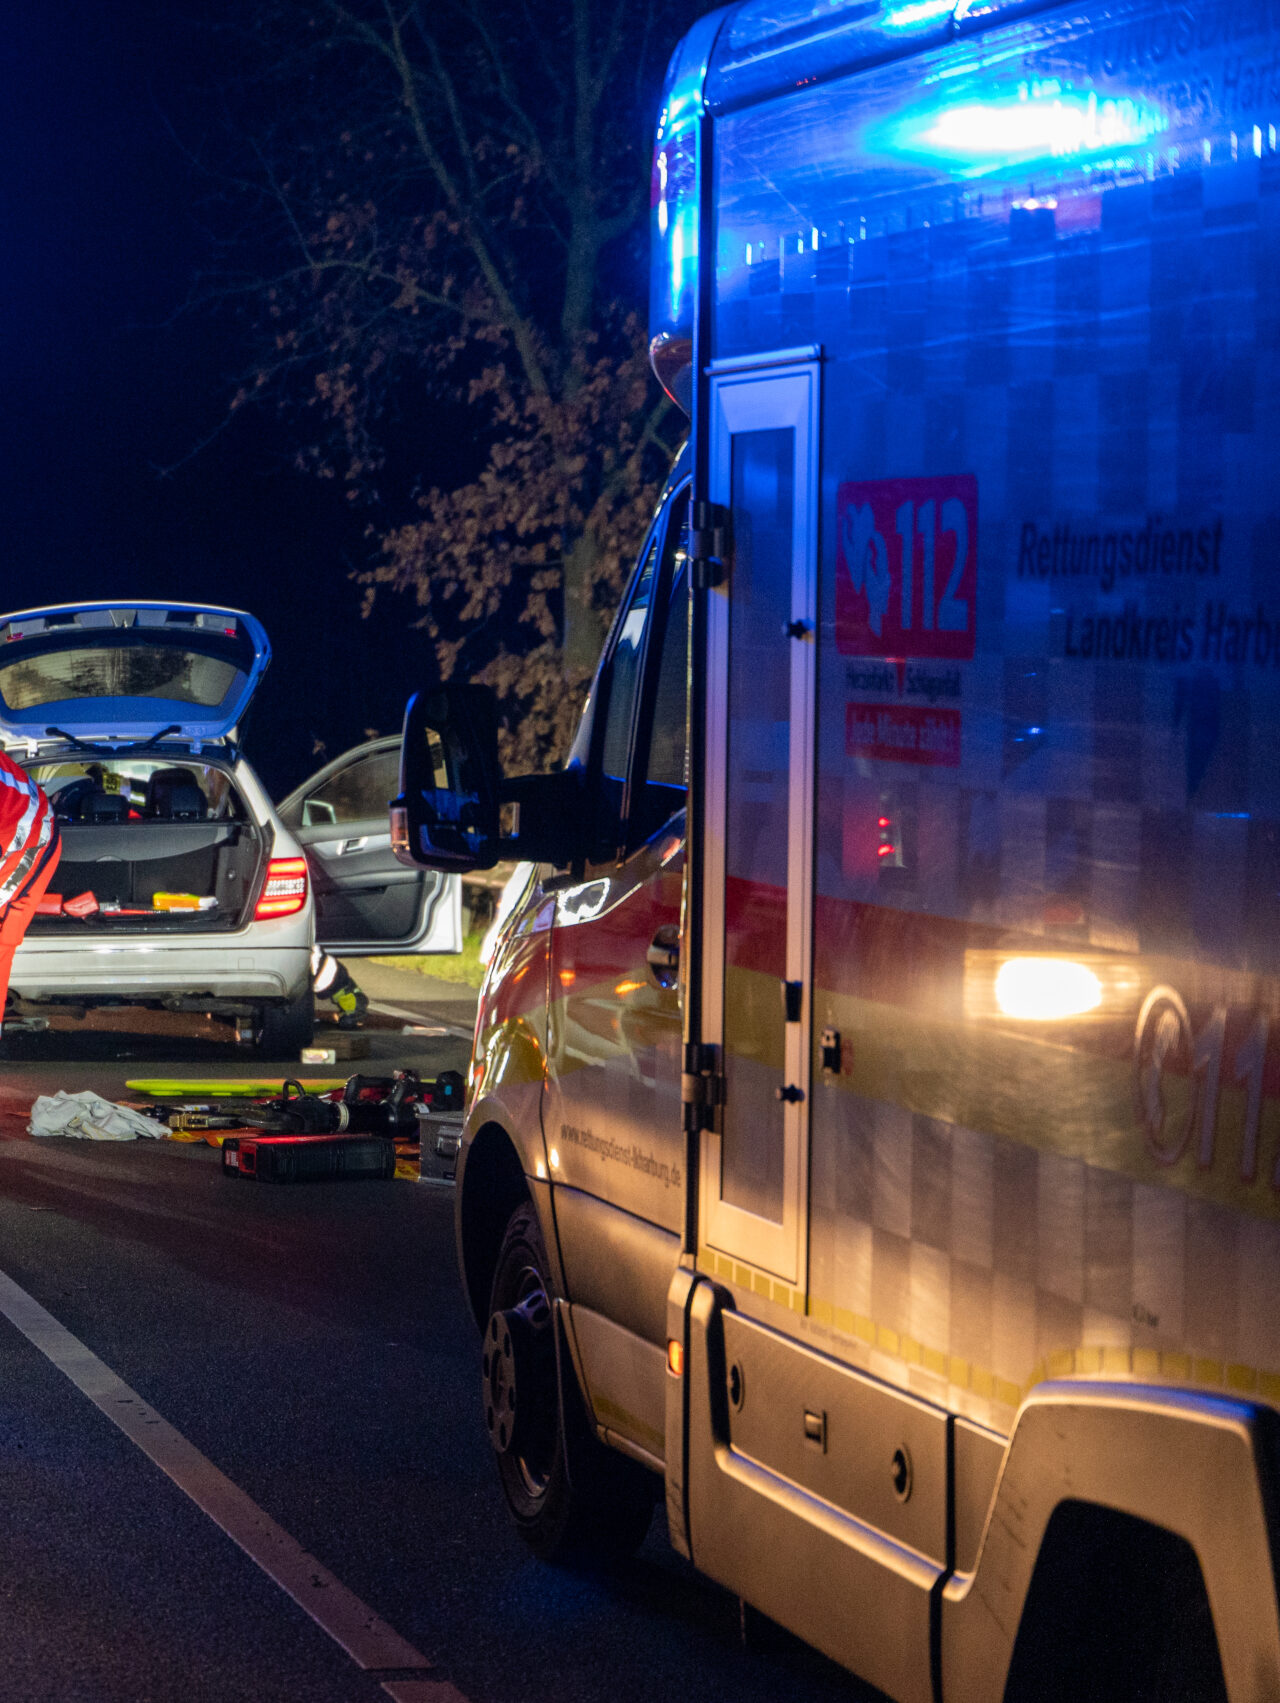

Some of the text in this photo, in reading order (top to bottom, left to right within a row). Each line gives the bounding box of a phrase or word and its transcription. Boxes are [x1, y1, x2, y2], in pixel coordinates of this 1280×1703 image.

[896, 498, 969, 631] 112
[1018, 515, 1224, 593] Rettungsdienst
[1065, 600, 1195, 661] Landkreis
